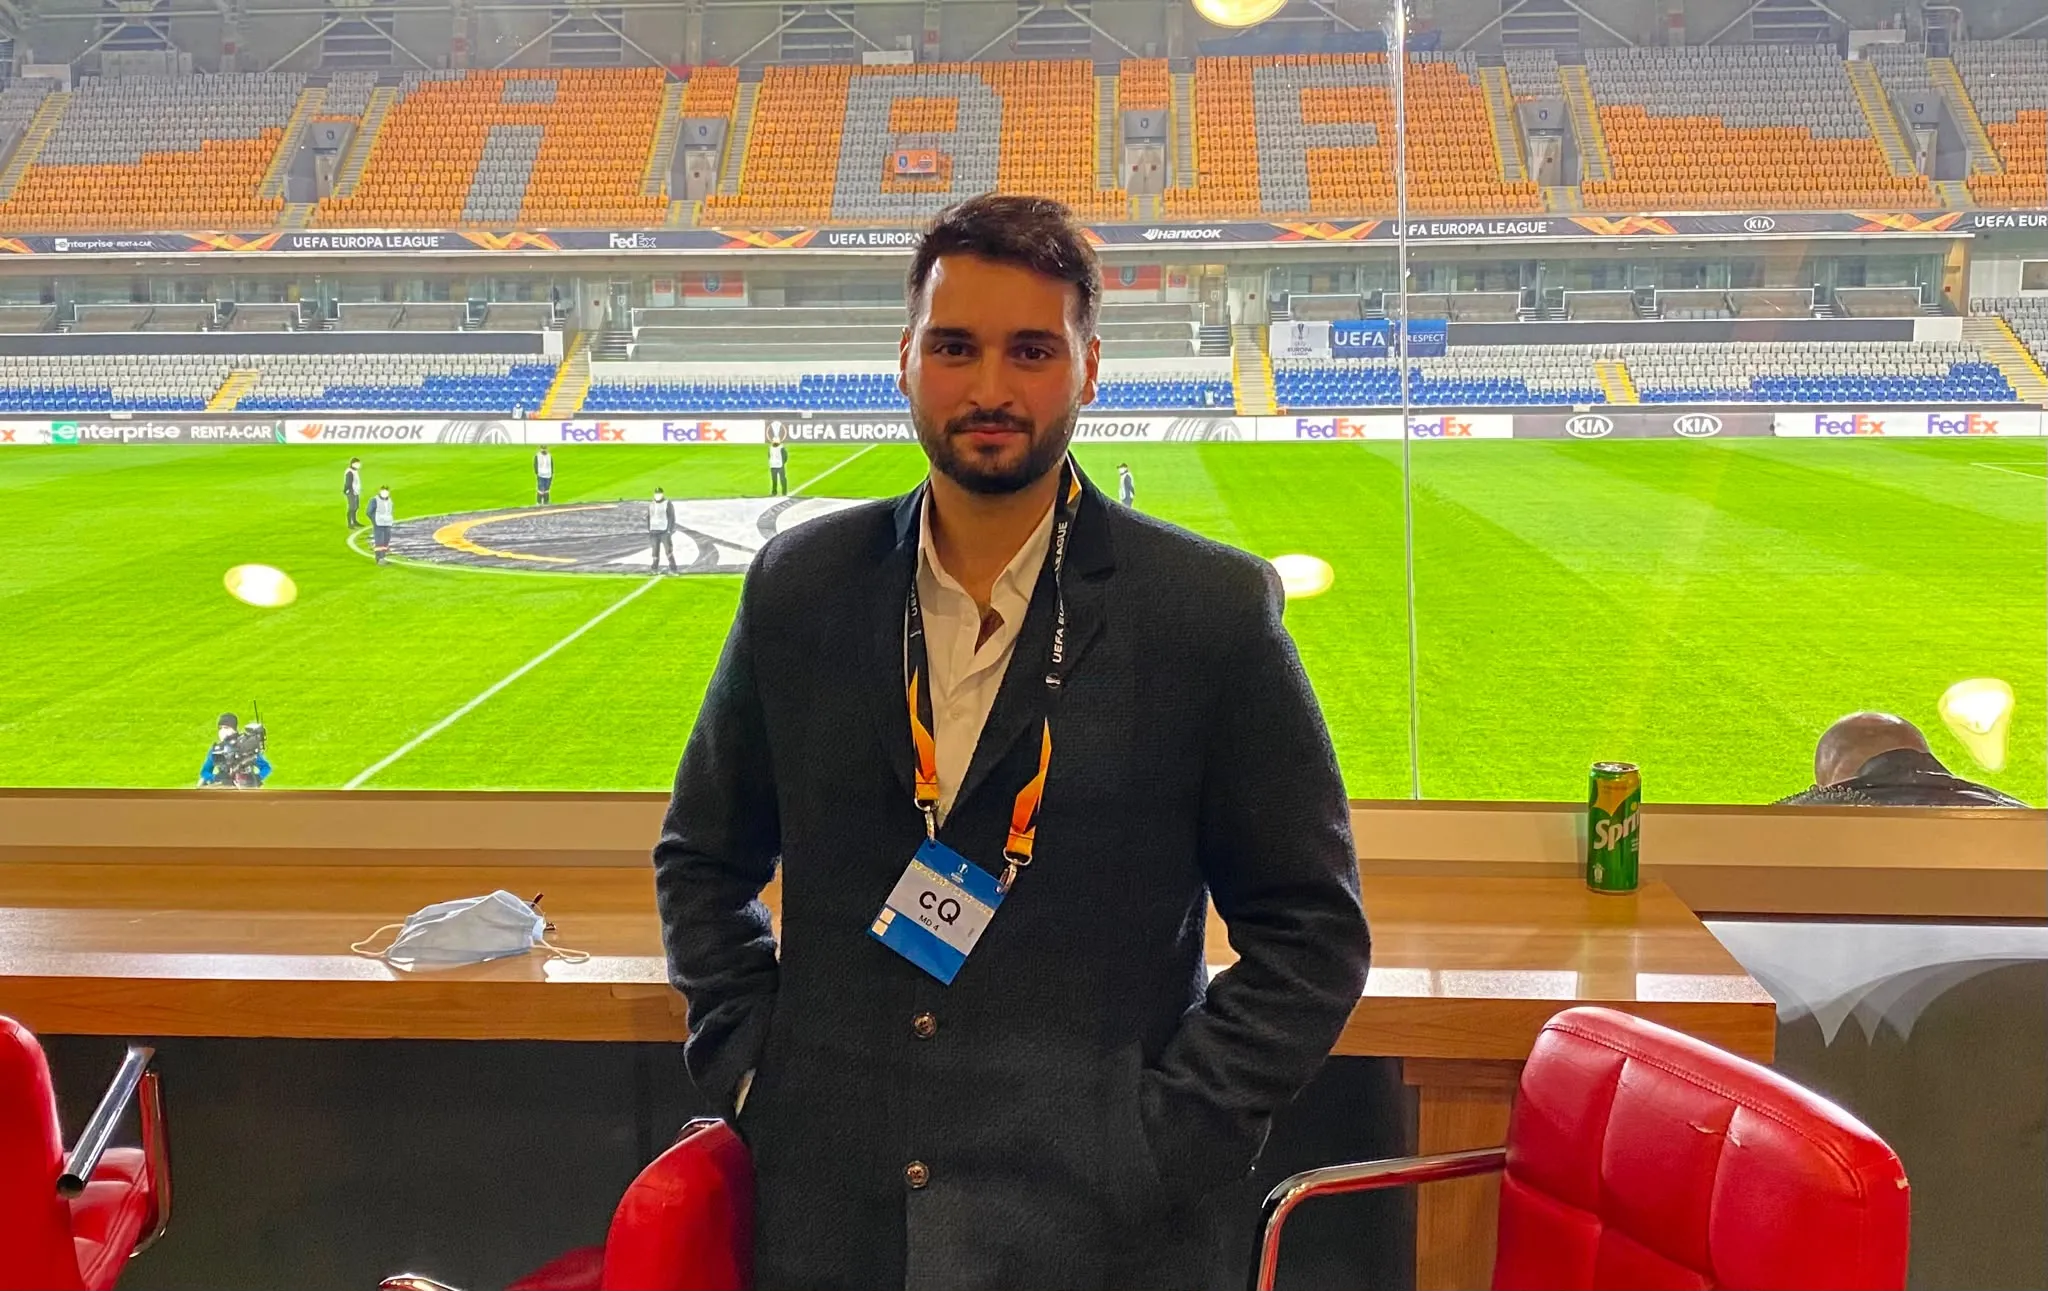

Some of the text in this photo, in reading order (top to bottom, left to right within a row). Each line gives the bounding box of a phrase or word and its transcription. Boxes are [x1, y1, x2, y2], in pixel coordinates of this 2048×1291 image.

[1974, 215, 2015, 227] UEFA
[1392, 222, 1547, 236] UFA EUROPA LEAGUE
[57, 239, 113, 250] enterprise
[293, 236, 439, 248] UEFA EUROPA LEAGUE
[609, 233, 657, 248] FedEx
[829, 234, 866, 245] UEFA
[1335, 331, 1386, 346] UEFA
[1407, 333, 1445, 343] RESPECT
[1296, 417, 1367, 438] FedEx
[1815, 414, 1886, 435] FedEx
[1928, 413, 1999, 434] FedEx
[54, 423, 272, 443] enterprise RENT-A-CAR
[561, 422, 626, 441] FedEx
[663, 422, 727, 441] FedEx
[788, 424, 834, 439] UEFA
[840, 424, 906, 439] EUROPA
[1052, 627, 1064, 663] UEFA
[918, 914, 940, 932] MD 4
